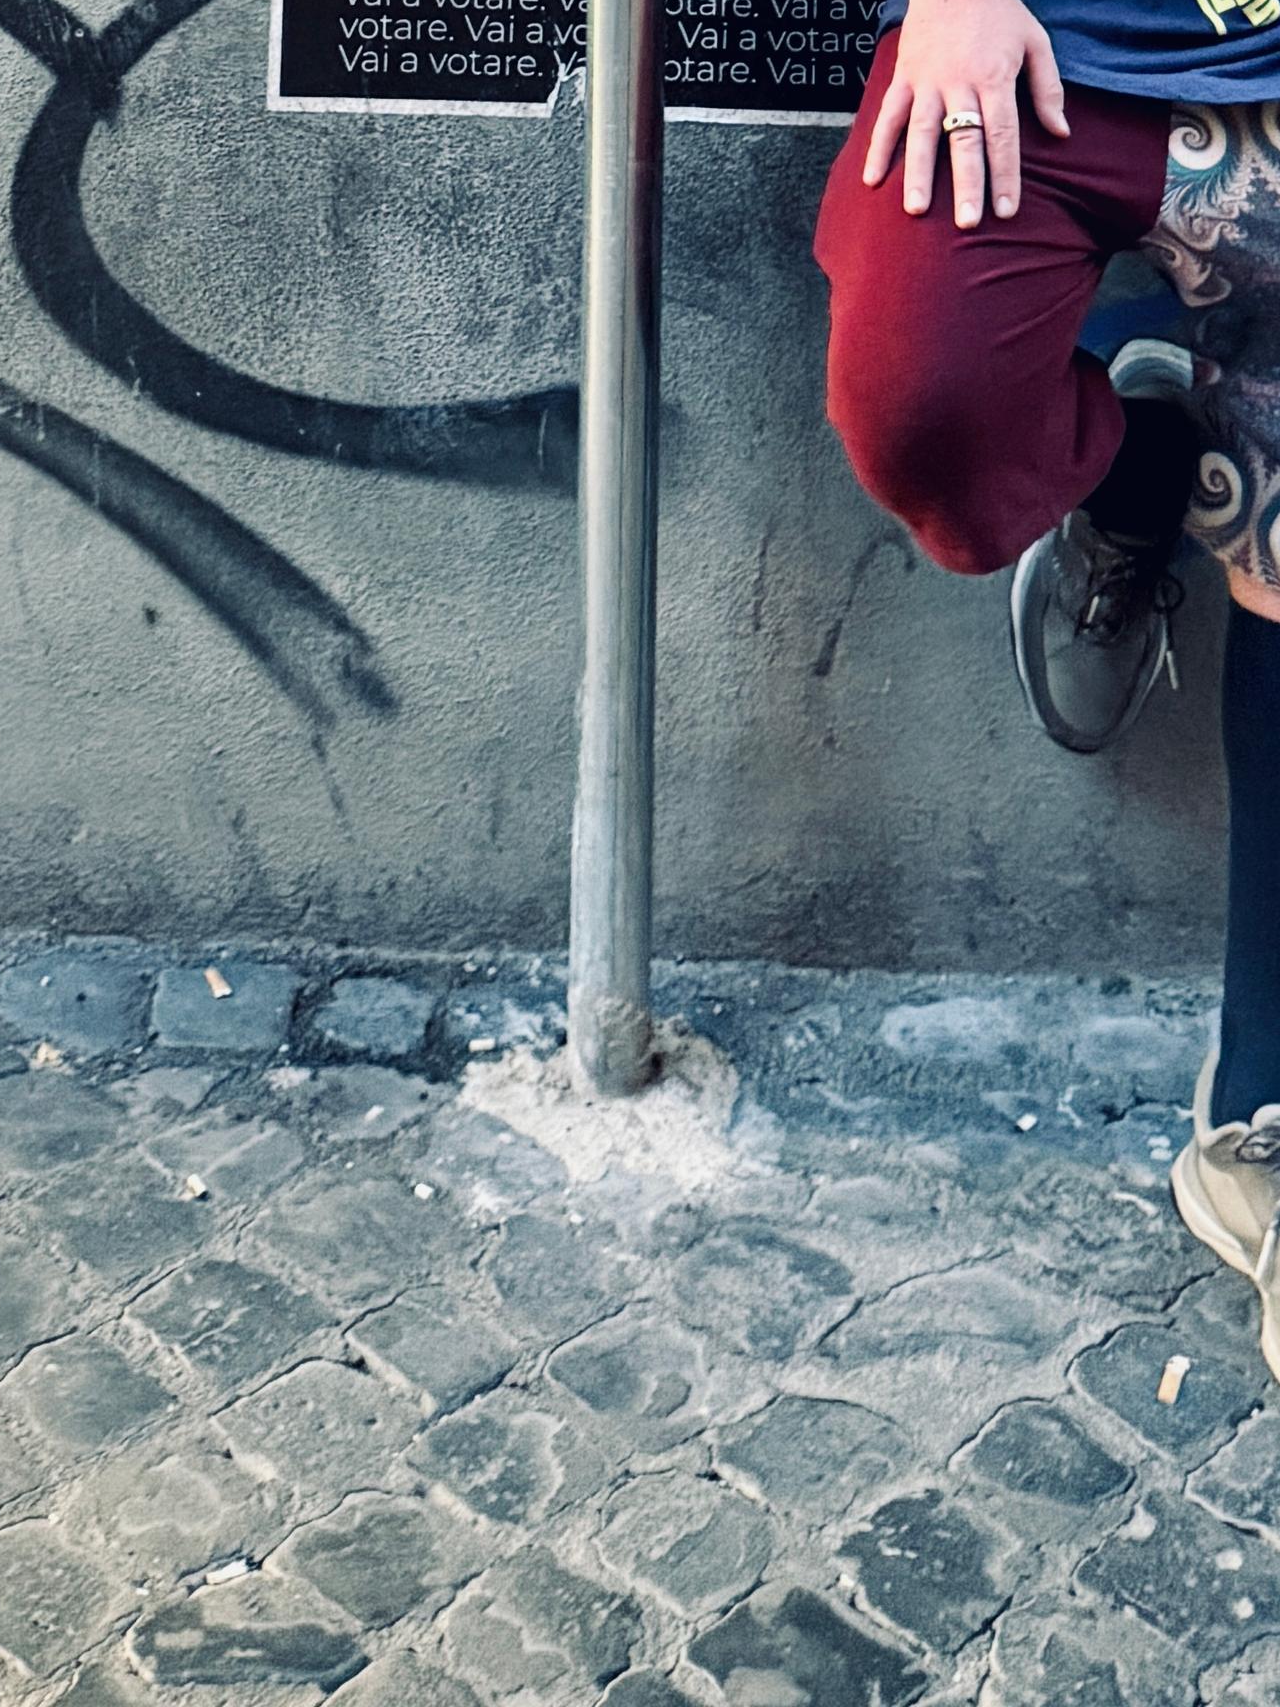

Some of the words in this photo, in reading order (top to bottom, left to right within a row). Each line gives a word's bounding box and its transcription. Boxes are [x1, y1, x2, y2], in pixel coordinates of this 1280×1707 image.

[829, 0, 847, 20] a
[339, 14, 454, 42] votare.
[464, 14, 514, 43] Vai
[526, 22, 543, 43] a
[678, 20, 728, 50] Vai
[739, 29, 757, 50] a
[338, 44, 389, 73] Vai
[400, 51, 418, 73] a
[429, 50, 543, 76] votare.
[664, 56, 757, 84] otare.
[766, 57, 816, 85] Vai
[828, 64, 846, 86] a
